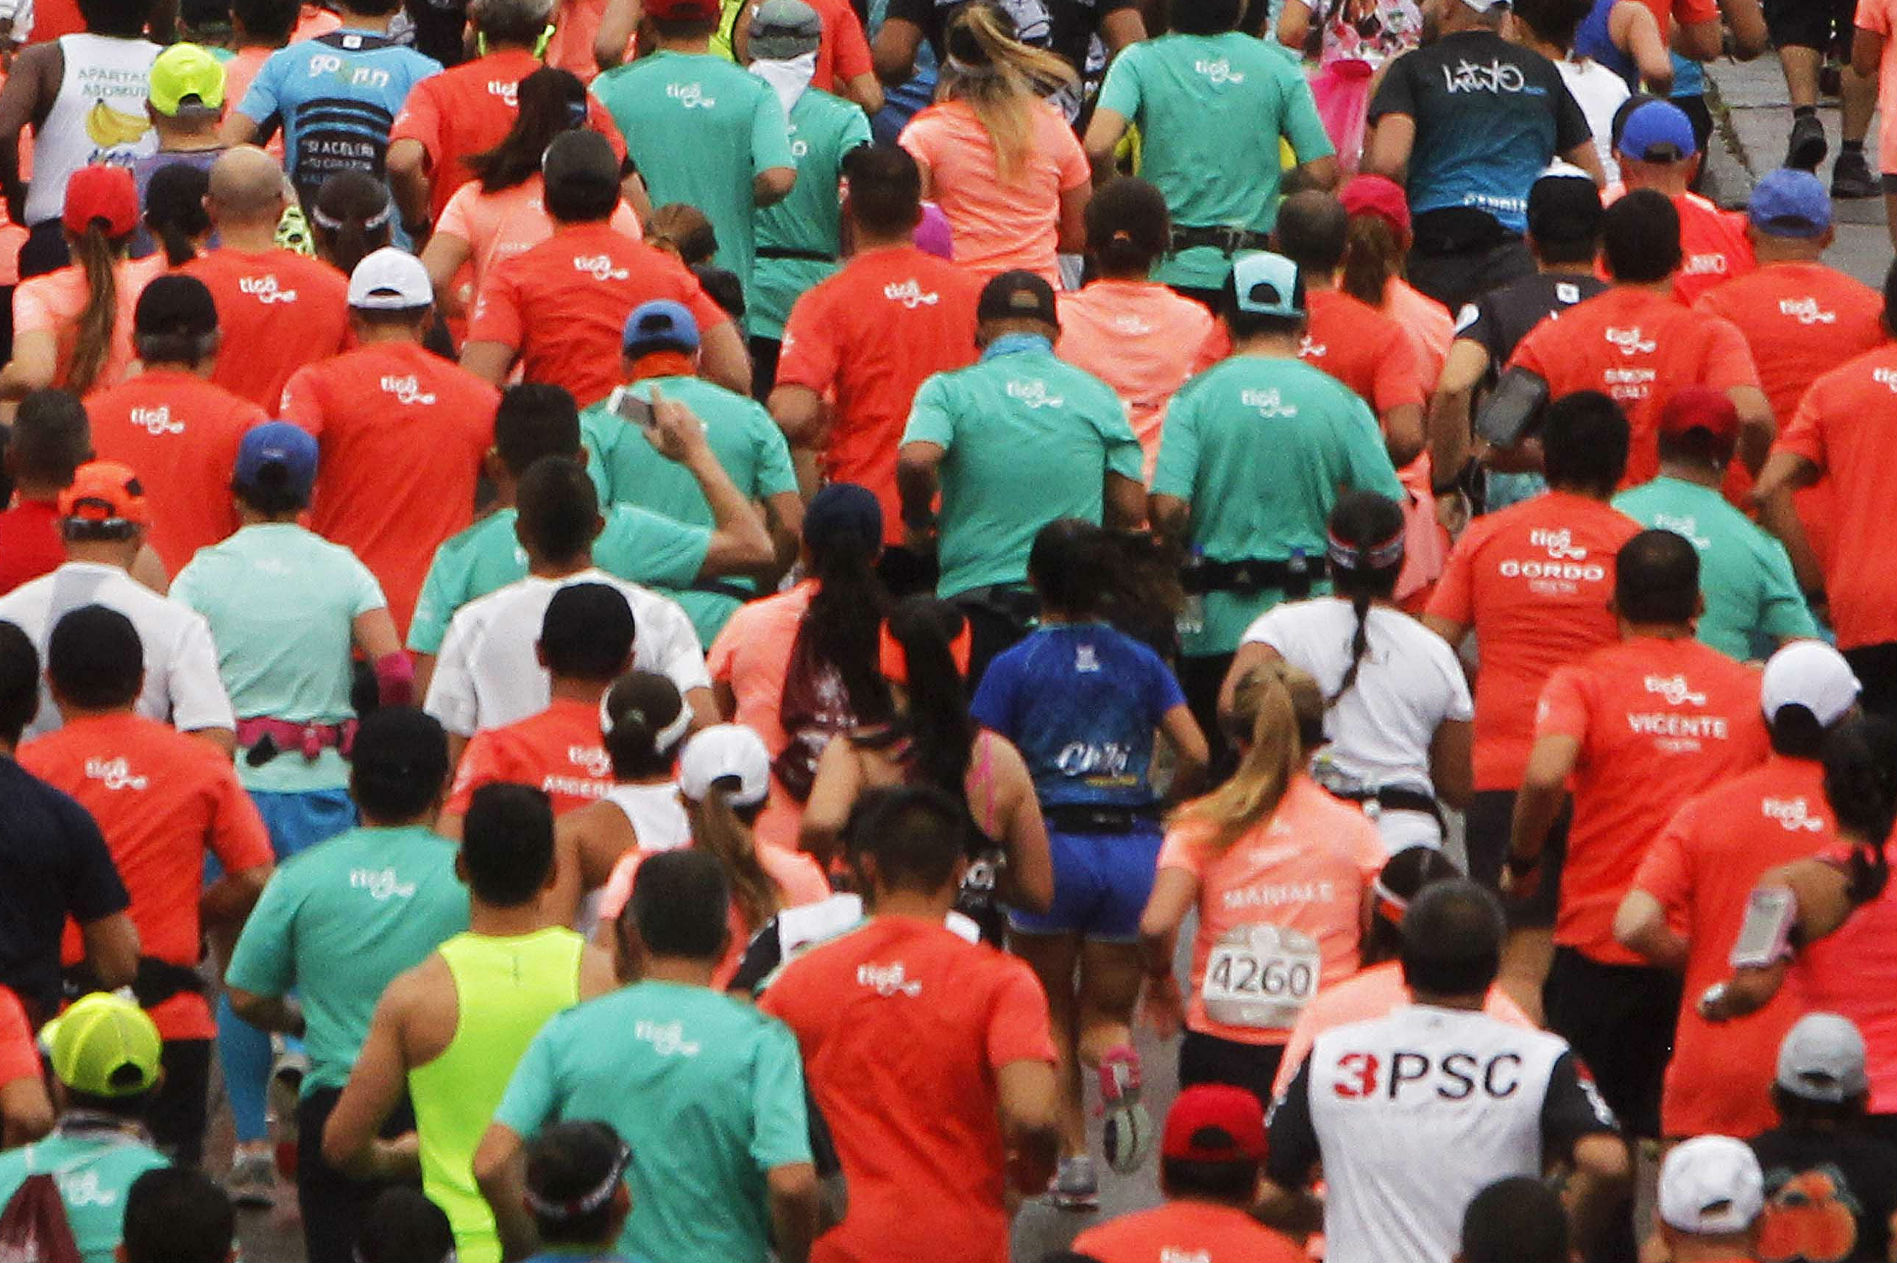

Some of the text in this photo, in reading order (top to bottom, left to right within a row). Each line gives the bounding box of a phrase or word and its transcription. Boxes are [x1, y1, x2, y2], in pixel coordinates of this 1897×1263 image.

[1499, 561, 1604, 582] GORDO
[1627, 712, 1729, 740] VICENTE
[1211, 955, 1313, 998] 4260
[1332, 1050, 1524, 1102] 3PSC
